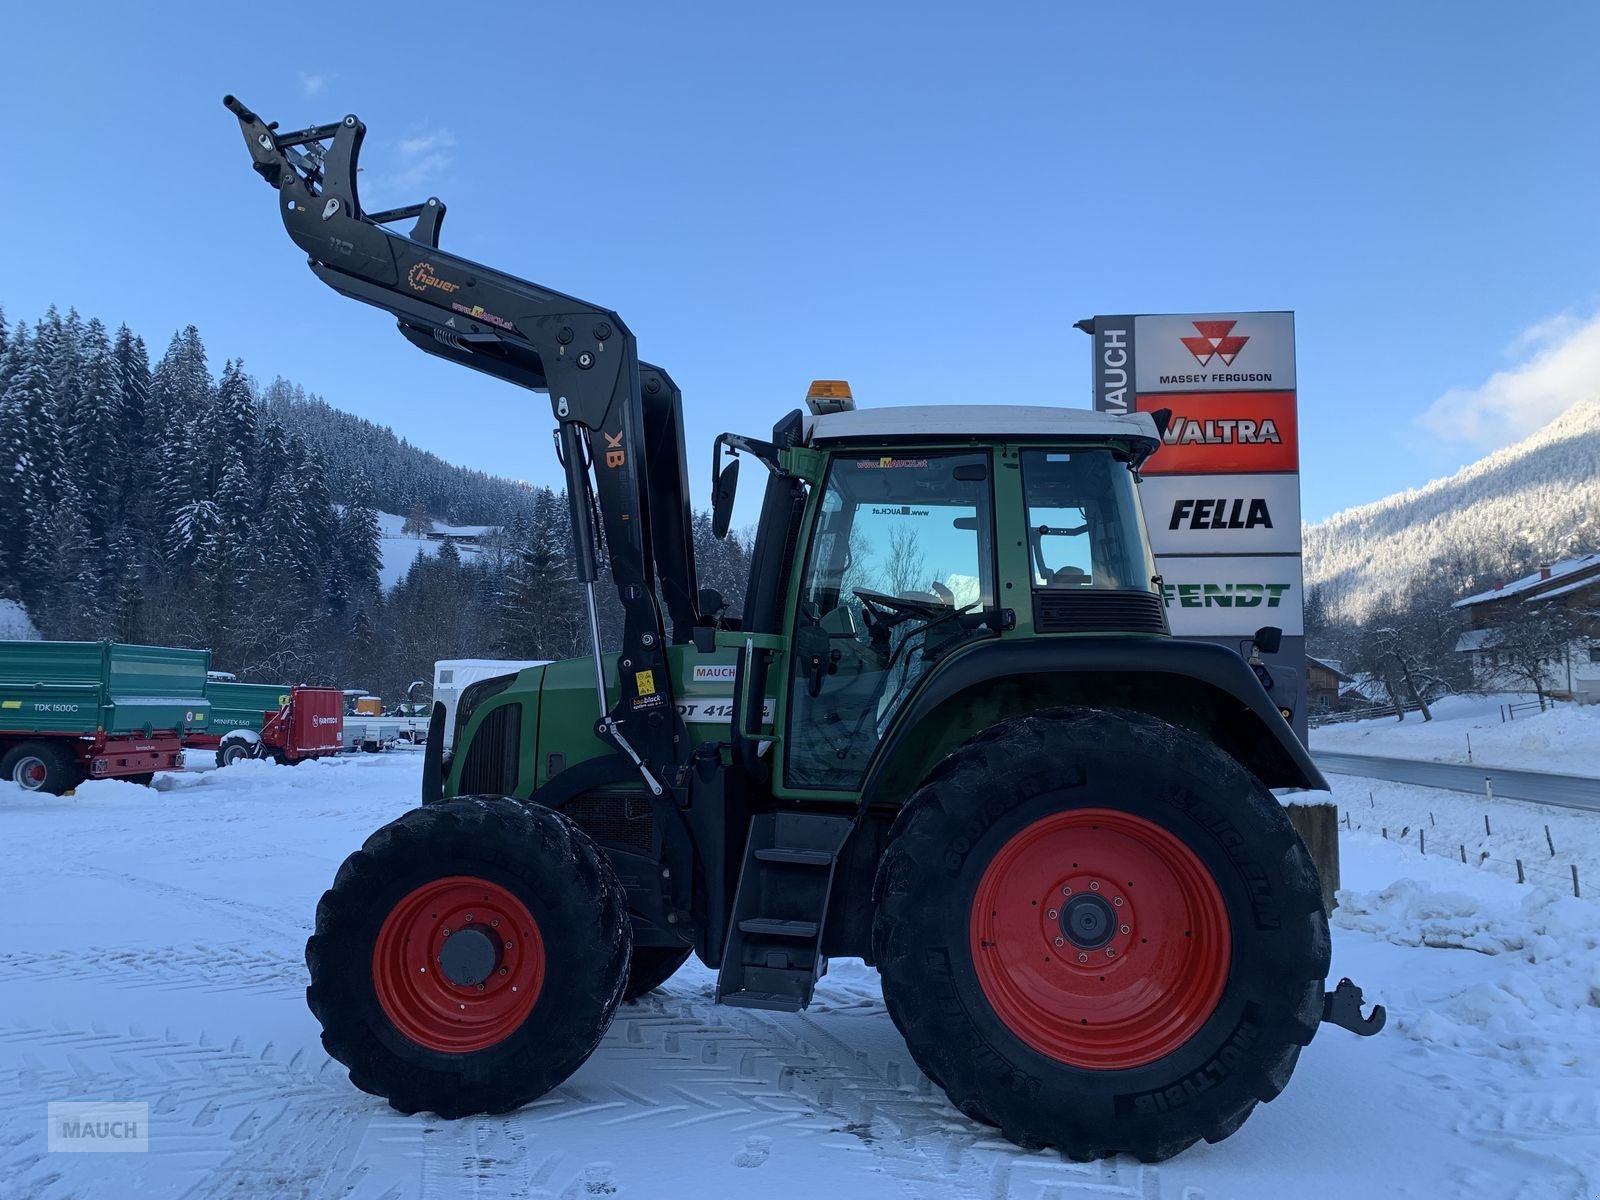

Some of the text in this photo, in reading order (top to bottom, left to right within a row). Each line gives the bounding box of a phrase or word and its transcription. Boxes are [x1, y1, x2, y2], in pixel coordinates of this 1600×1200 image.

[416, 269, 460, 293] hauer
[1160, 373, 1272, 384] MASSEY FERGUSON
[1163, 417, 1281, 445] VALTRA
[1169, 499, 1273, 529] FELLA
[1163, 584, 1291, 607] FENDT
[696, 668, 736, 677] MAUCH
[33, 703, 80, 713] TDK 1500C
[1134, 1018, 1260, 1116] MULTIBIB
